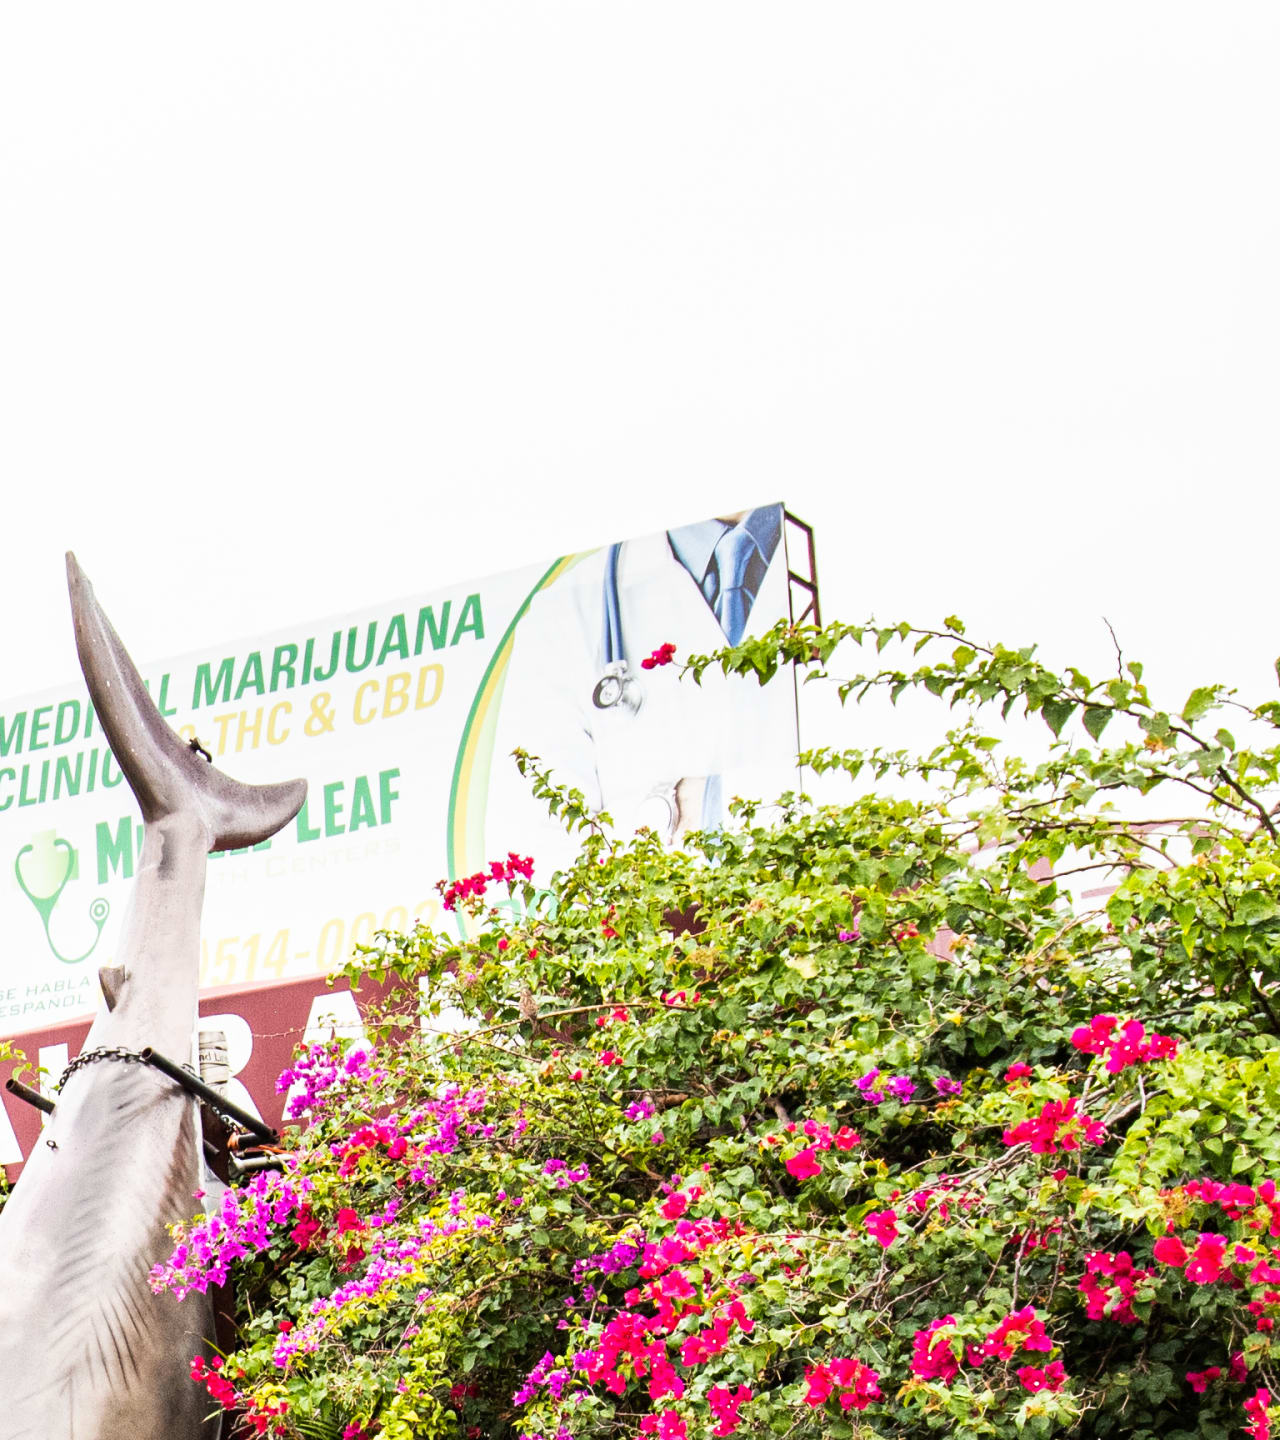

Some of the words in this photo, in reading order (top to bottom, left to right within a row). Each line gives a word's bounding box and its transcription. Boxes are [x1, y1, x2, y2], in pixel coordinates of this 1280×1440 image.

[191, 593, 486, 711] MARIJUANA
[303, 690, 336, 737] &
[352, 663, 446, 726] CBD
[296, 767, 401, 844] LEAF
[25, 975, 91, 997] HABLA
